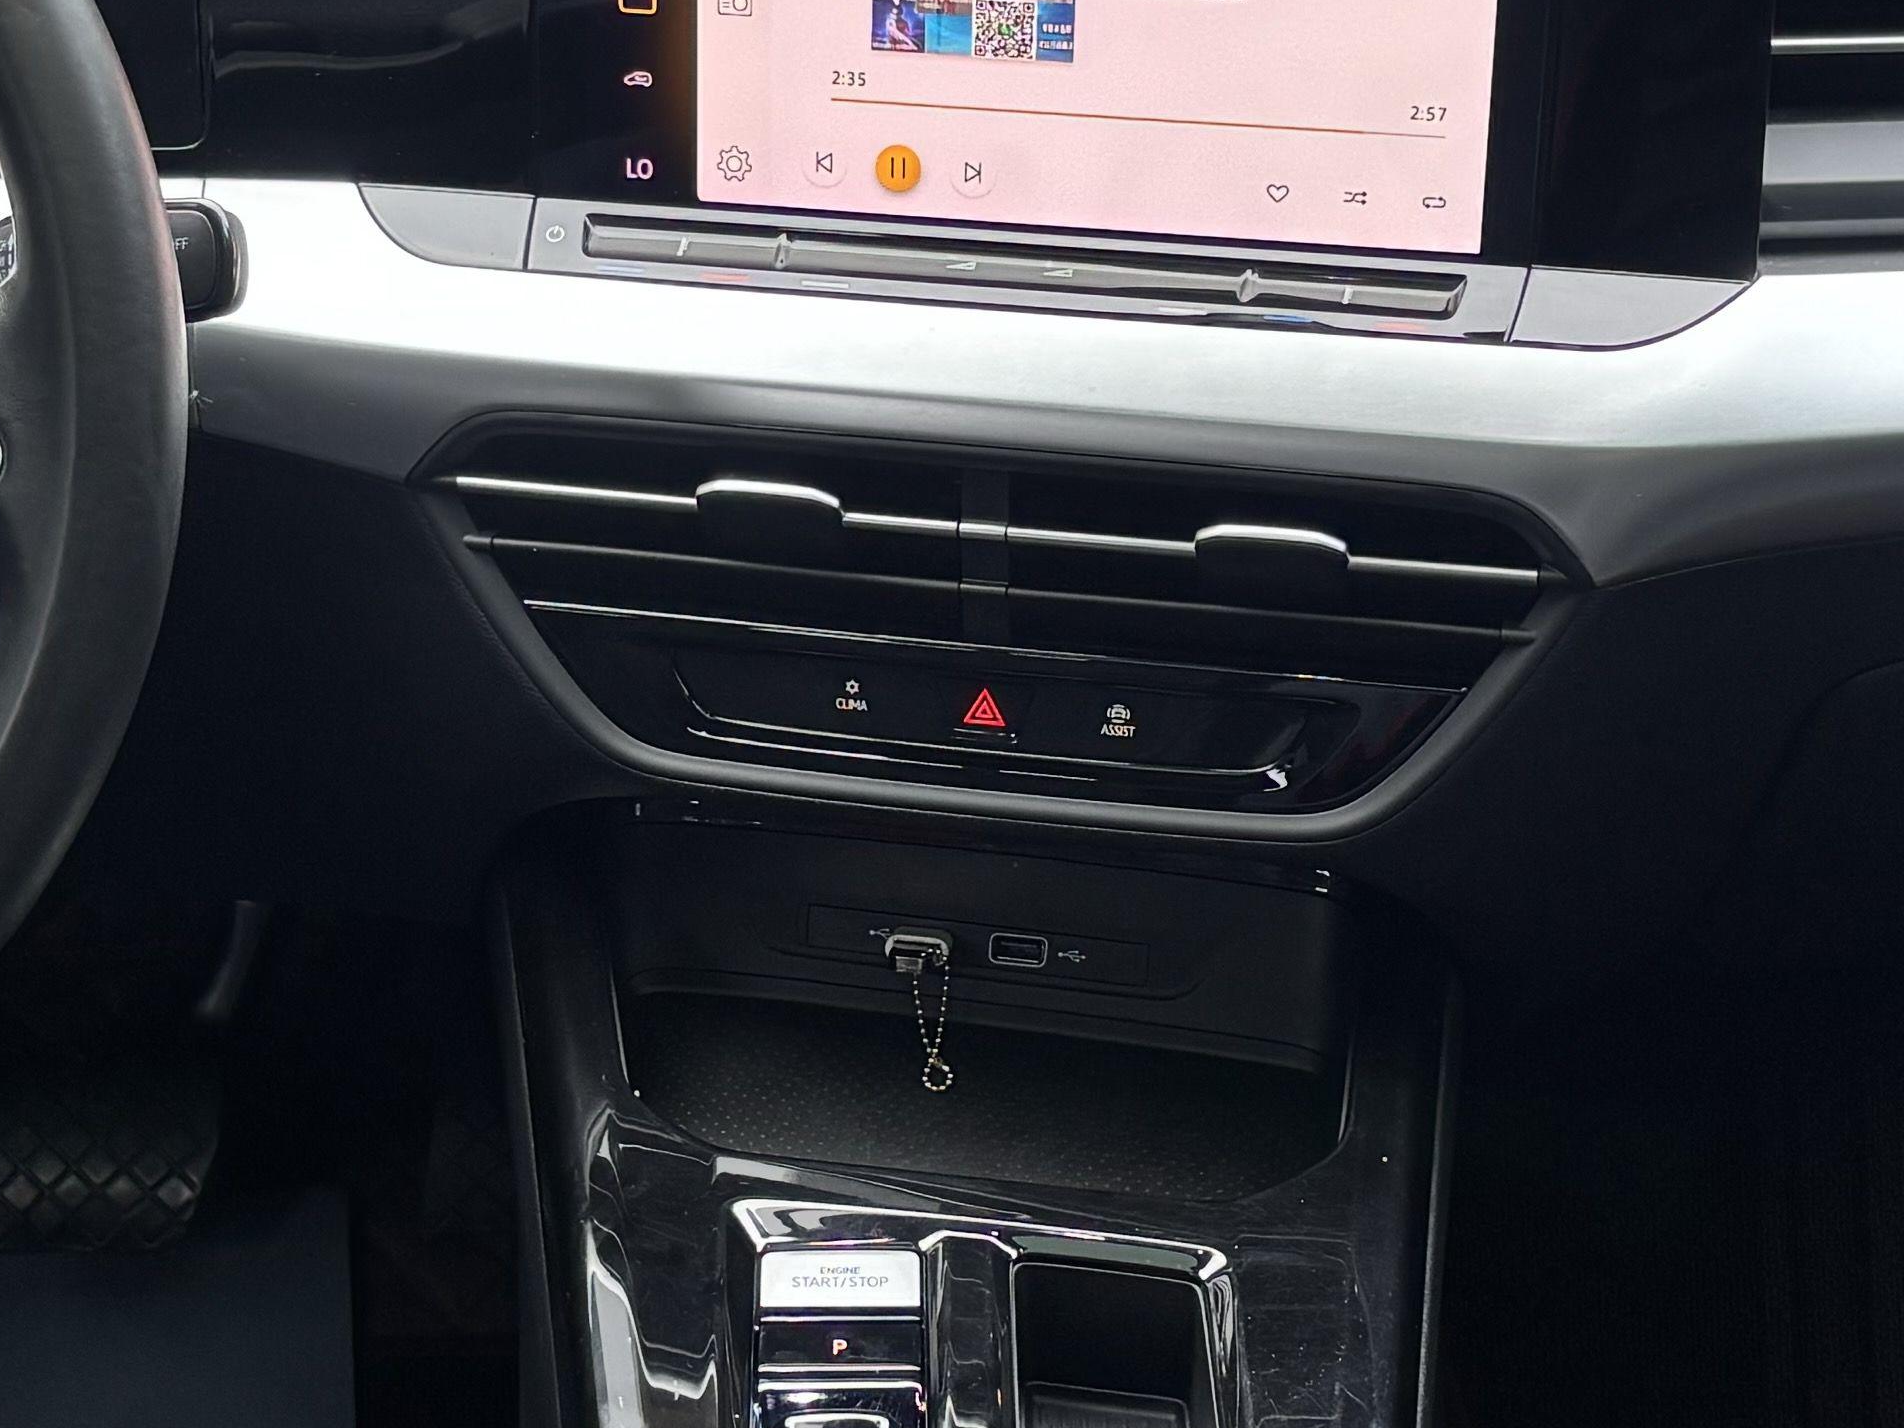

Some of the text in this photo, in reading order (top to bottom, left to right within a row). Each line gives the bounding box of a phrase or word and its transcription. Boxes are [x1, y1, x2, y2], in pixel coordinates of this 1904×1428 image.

[831, 70, 866, 87] 2:35
[1410, 105, 1447, 122] 2:57
[626, 157, 654, 180] LO
[835, 697, 868, 711] CLIMA
[1100, 723, 1136, 737] ASSIST
[819, 1266, 861, 1275] ENGINE
[791, 1275, 889, 1288] START/STOP
[832, 1338, 848, 1356] P
